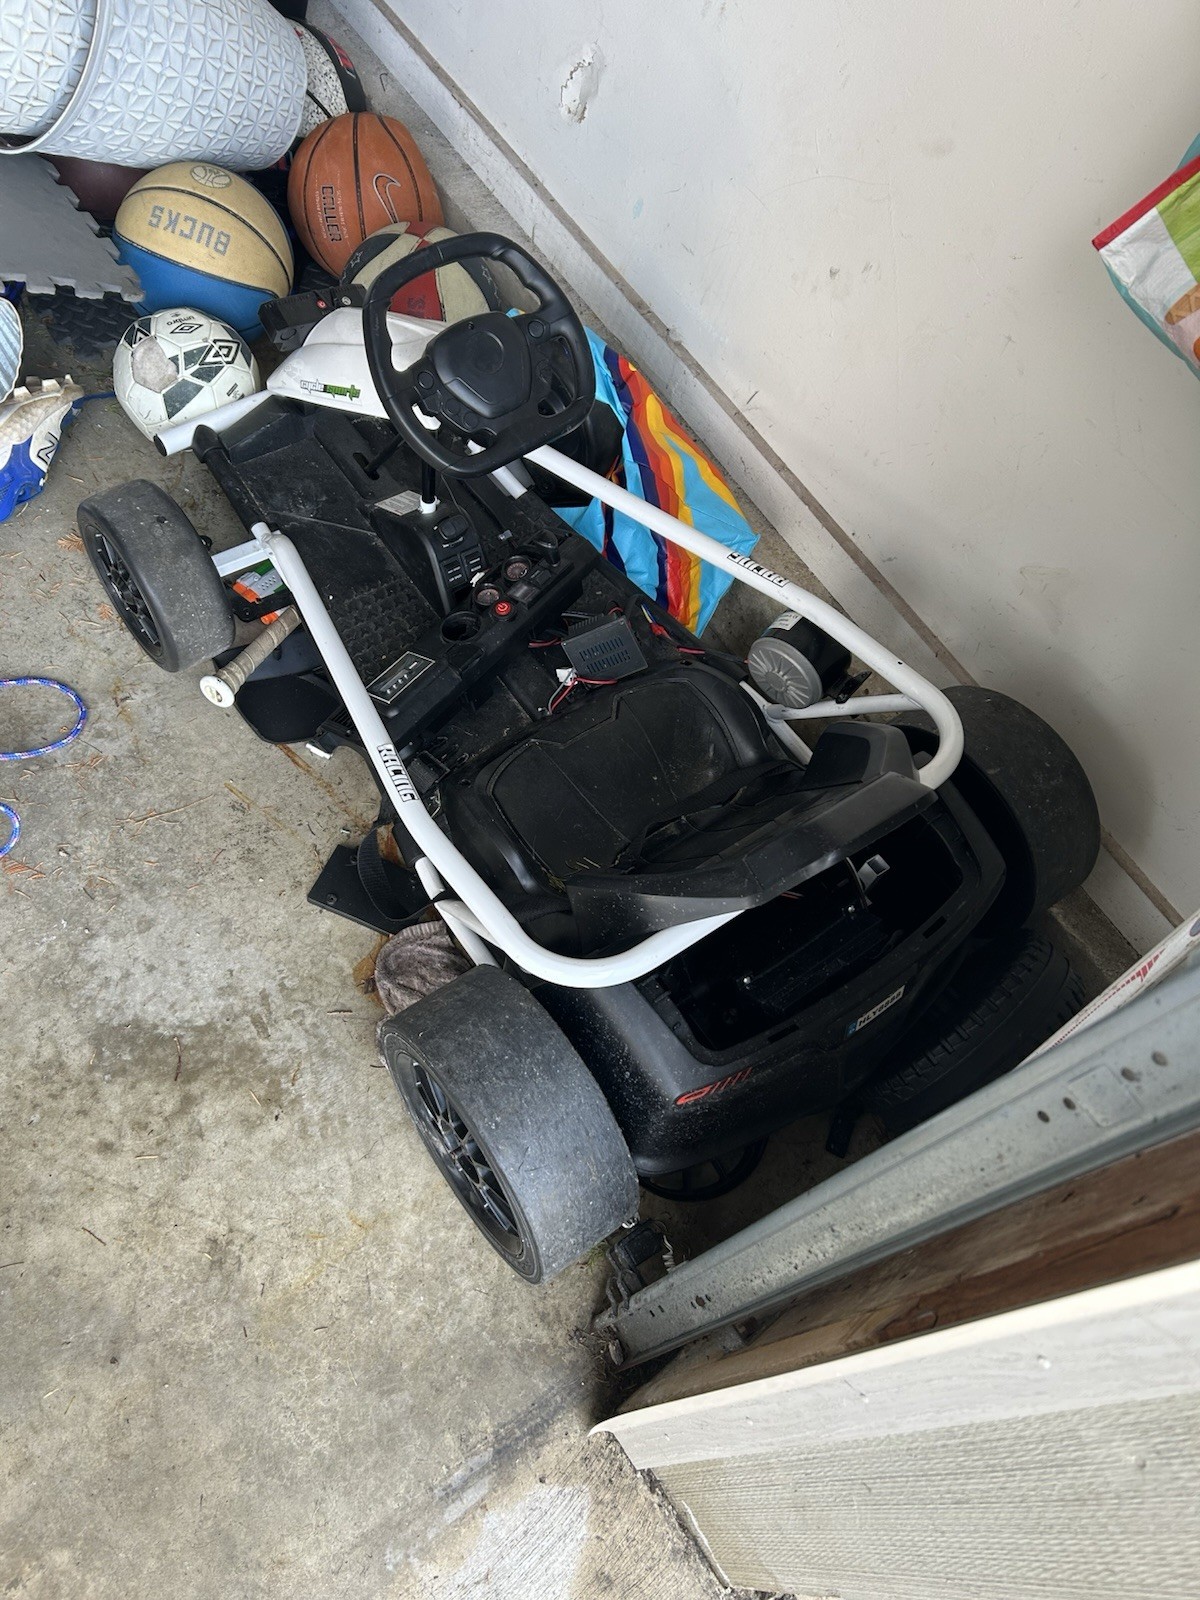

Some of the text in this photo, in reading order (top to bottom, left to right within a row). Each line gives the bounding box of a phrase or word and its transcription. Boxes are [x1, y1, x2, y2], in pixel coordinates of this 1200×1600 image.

[147, 205, 231, 256] BUCKS
[166, 315, 196, 326] umbro
[377, 742, 420, 802] RACING
